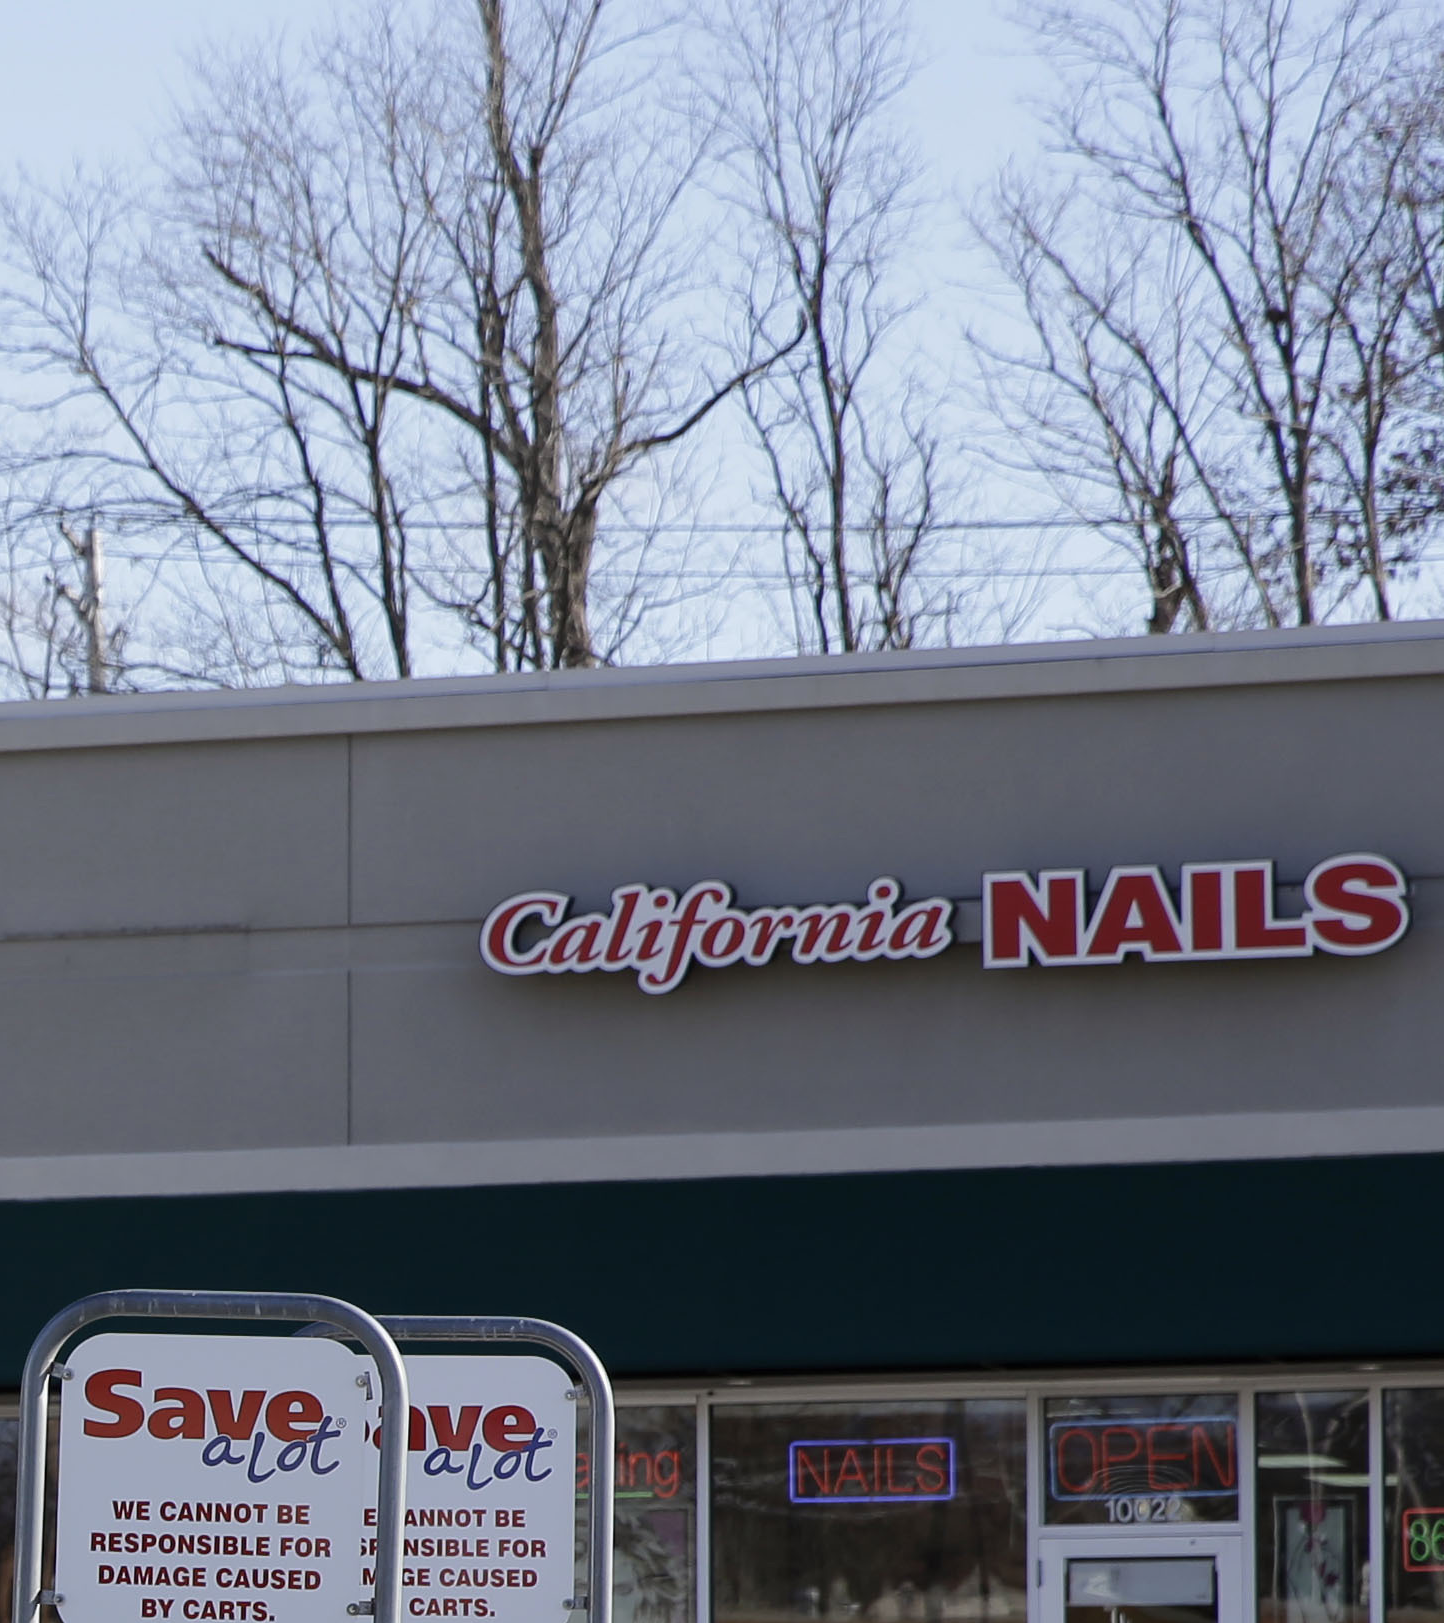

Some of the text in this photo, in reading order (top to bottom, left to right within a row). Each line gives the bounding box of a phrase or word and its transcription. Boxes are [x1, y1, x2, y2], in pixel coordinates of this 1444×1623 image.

[483, 858, 1406, 989] California NAILS
[83, 1369, 324, 1443] Save
[797, 1444, 947, 1495] NAILS
[1057, 1424, 1236, 1493] OPEN
[112, 1500, 311, 1525] WE CANNOT BE
[495, 1509, 526, 1528] BE
[1105, 1497, 1183, 1523] 10022
[90, 1532, 331, 1558] RESPONSIBLE FOR
[498, 1539, 546, 1558] FOR
[98, 1564, 322, 1591] DAMAGE CAUSED
[439, 1568, 538, 1588] CAUSED
[141, 1598, 276, 1623] BY CARTS.
[409, 1597, 496, 1617] CARTS.
